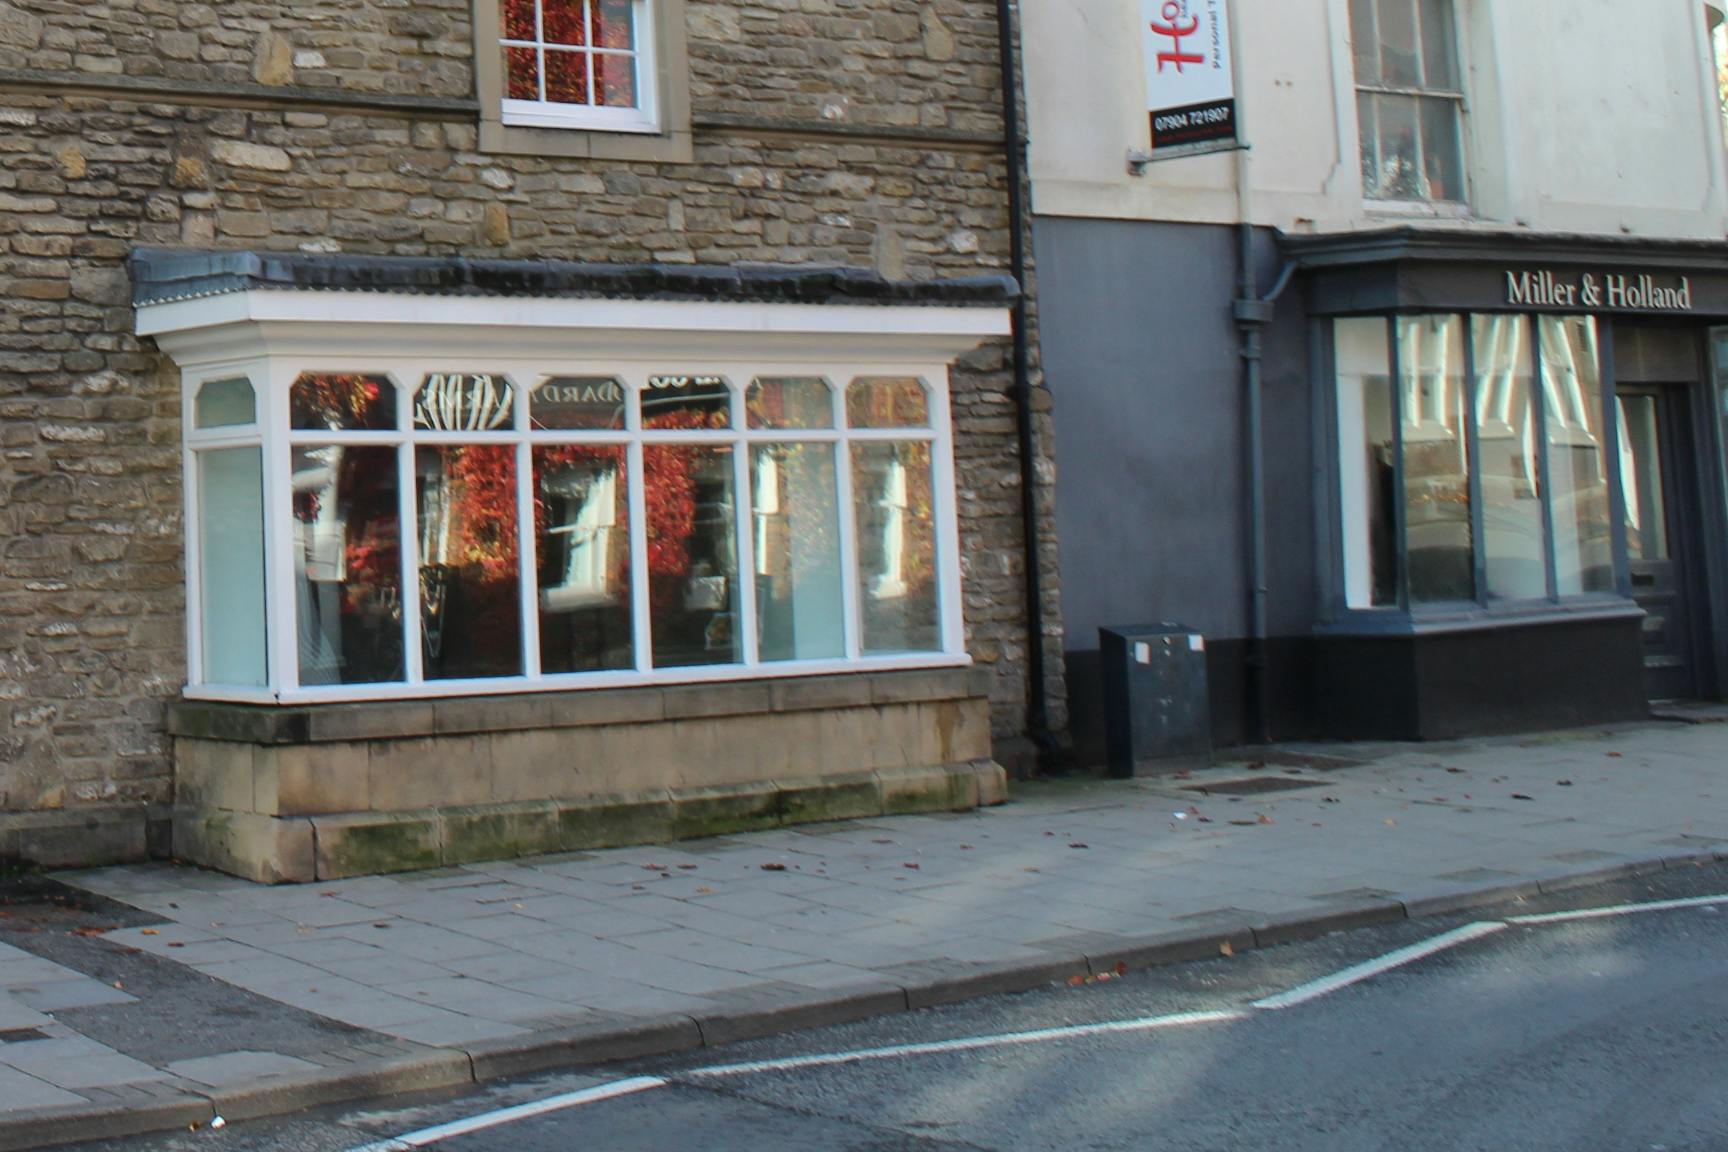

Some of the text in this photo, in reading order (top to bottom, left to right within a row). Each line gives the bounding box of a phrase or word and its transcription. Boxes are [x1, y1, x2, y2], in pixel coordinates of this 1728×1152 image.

[1207, 10, 1221, 70] Personal
[1505, 270, 1693, 310] Miller & Holland
